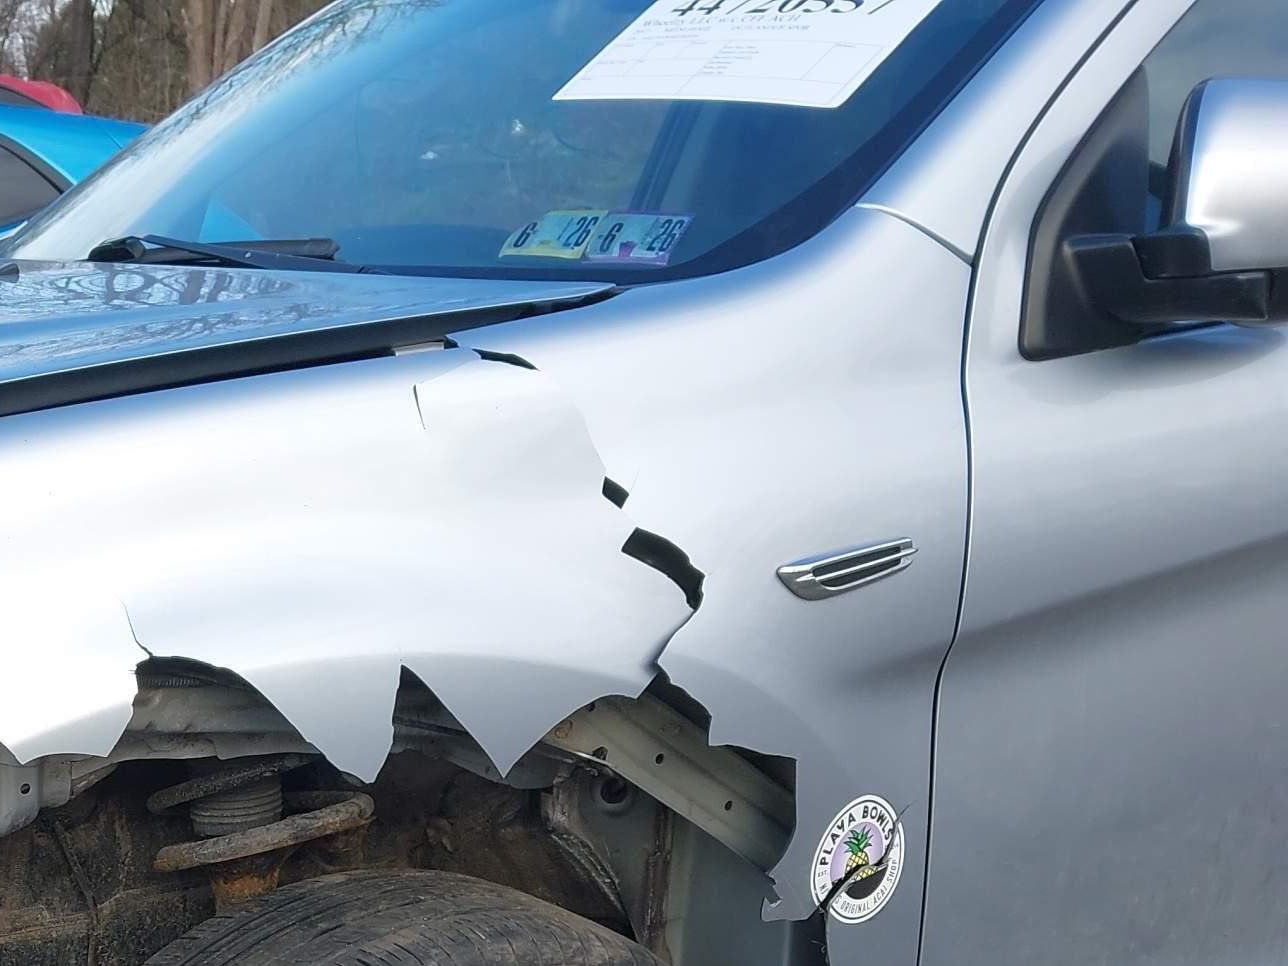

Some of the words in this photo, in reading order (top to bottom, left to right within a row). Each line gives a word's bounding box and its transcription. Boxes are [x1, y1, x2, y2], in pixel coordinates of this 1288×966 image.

[819, 812, 856, 866] PLAYA
[862, 805, 894, 840] BOWLS
[840, 900, 871, 914] ORIGINAL
